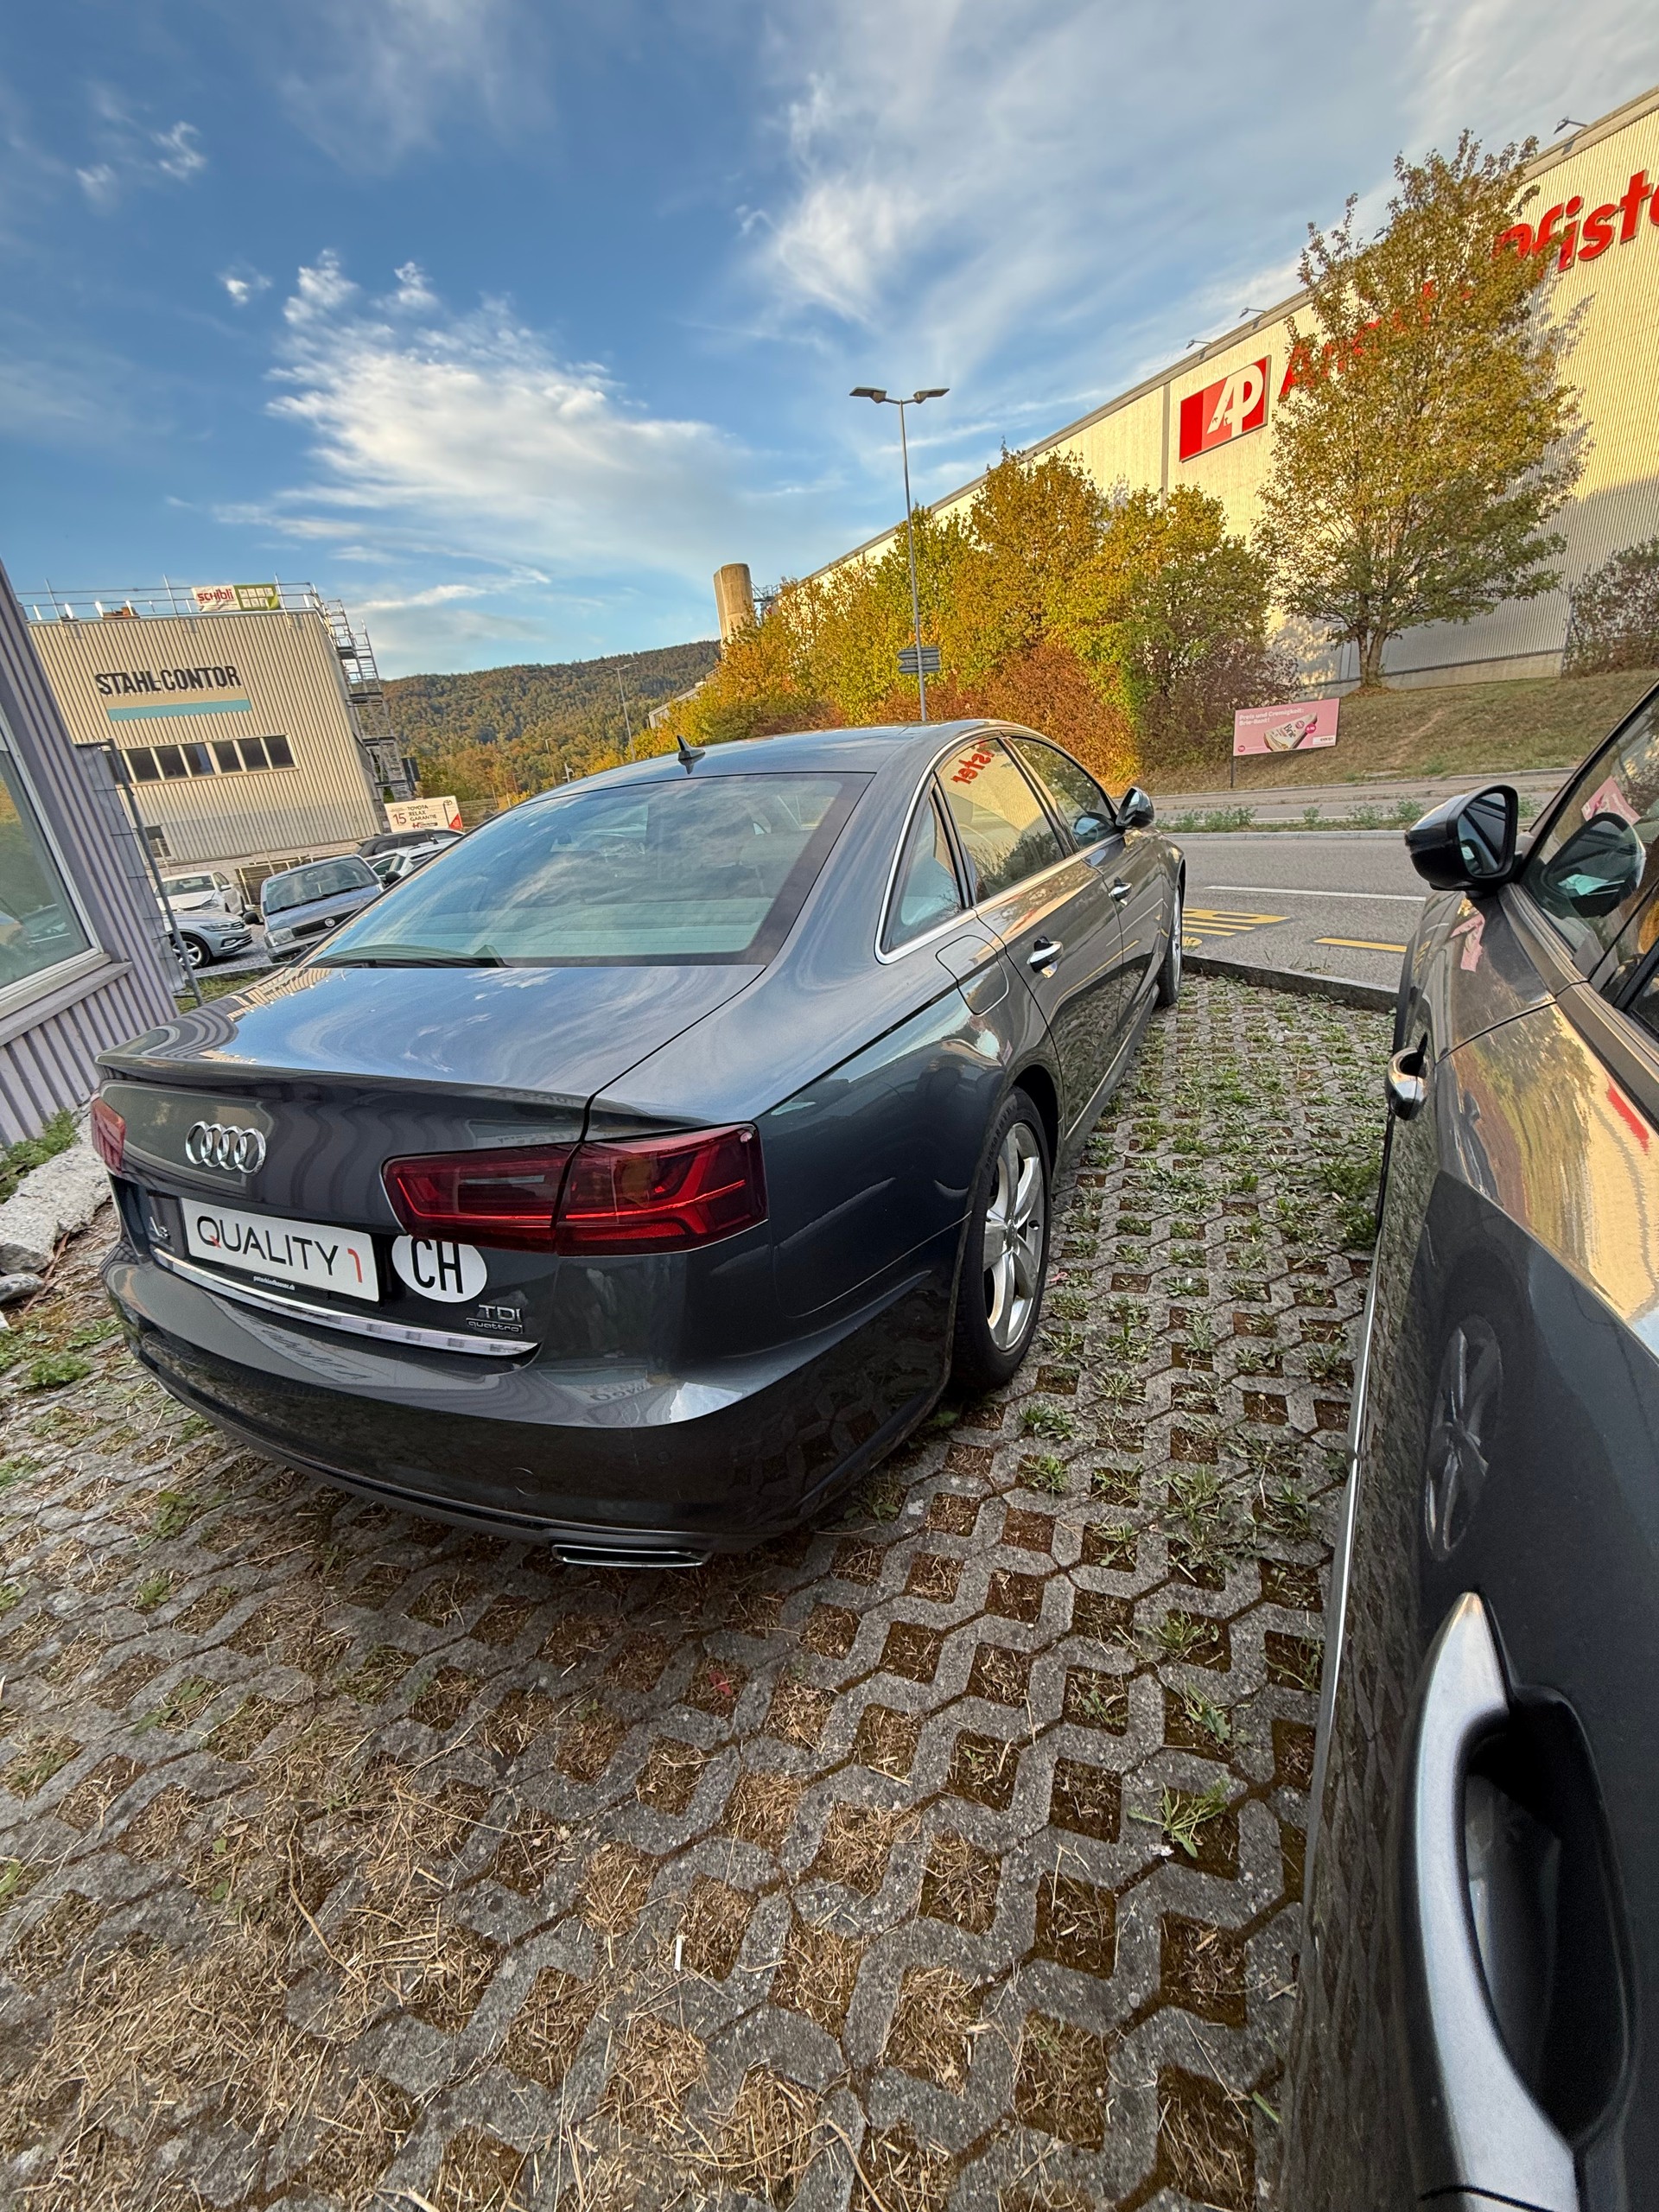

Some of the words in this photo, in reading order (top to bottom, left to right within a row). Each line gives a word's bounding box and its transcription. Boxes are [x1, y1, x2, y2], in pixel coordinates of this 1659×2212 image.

[393, 812, 407, 825] 15
[197, 1215, 339, 1276] QUALITY
[347, 1248, 363, 1283] 1
[410, 1236, 464, 1294] CH
[478, 1304, 522, 1323] TDI
[468, 1320, 519, 1332] quattro
